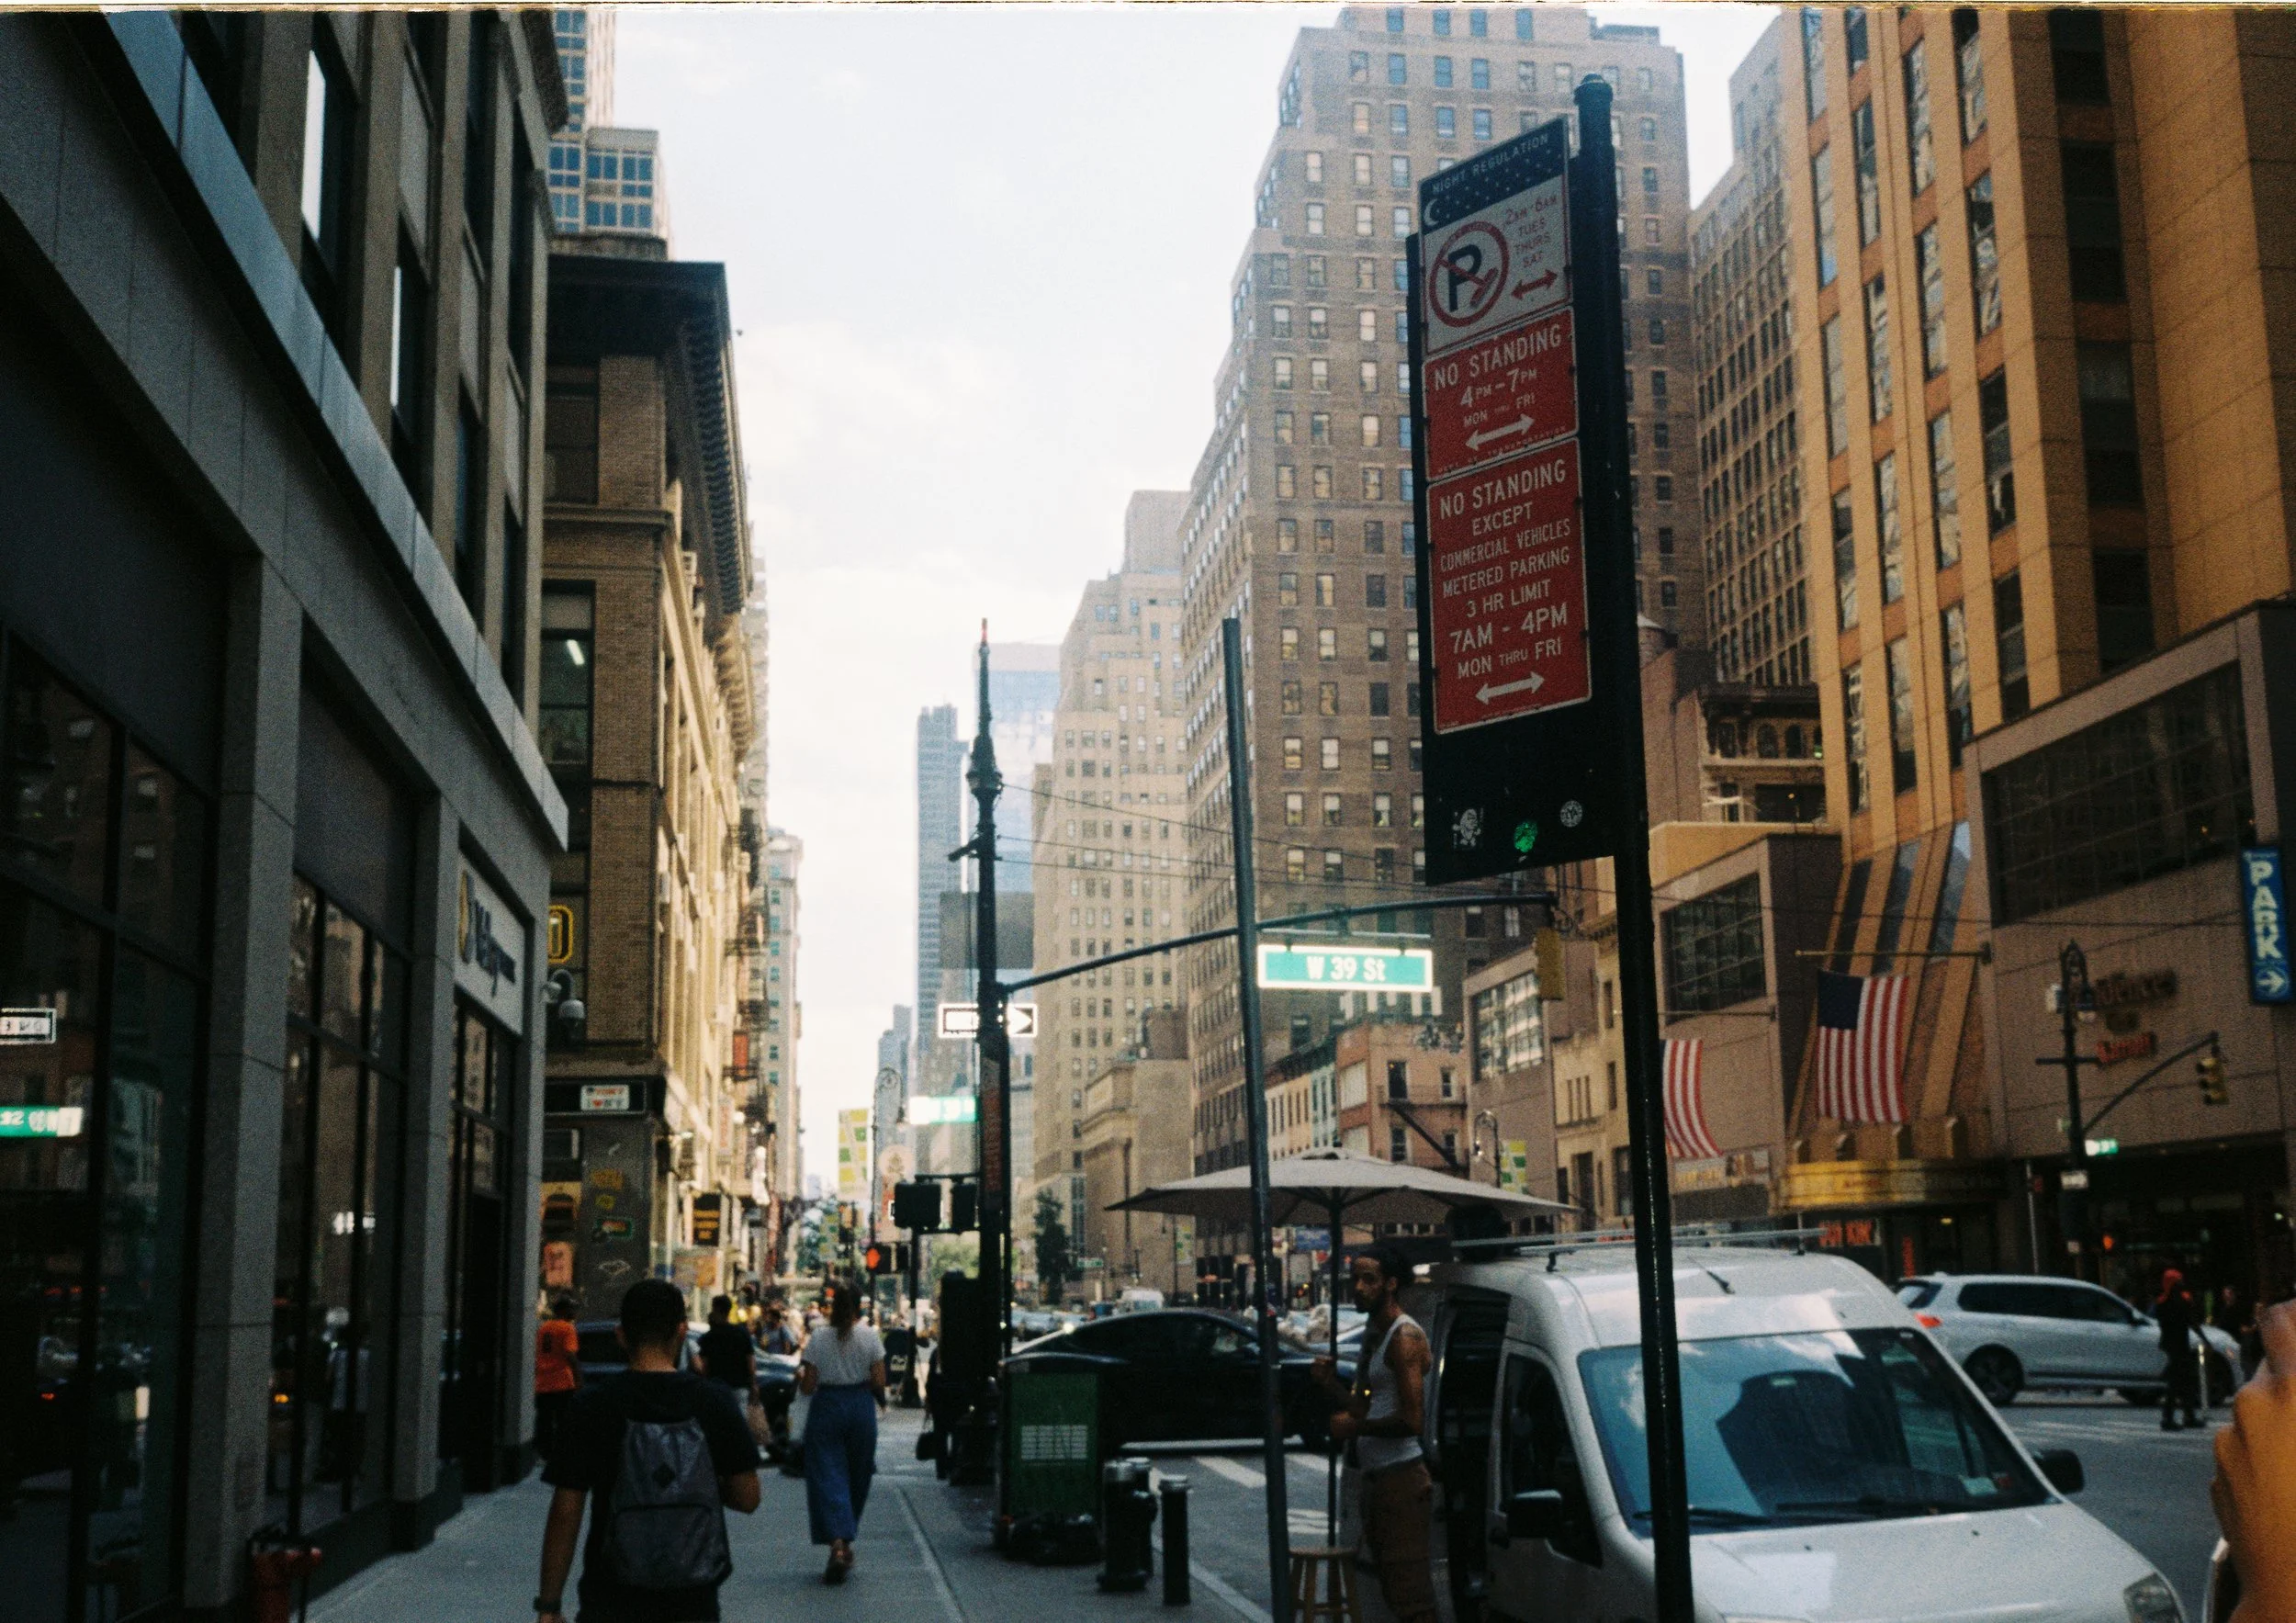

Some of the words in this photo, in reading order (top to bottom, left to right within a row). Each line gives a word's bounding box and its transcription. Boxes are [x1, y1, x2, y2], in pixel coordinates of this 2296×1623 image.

[1432, 170, 1465, 195] NIGHT
[1472, 133, 1548, 175] REGULATION
[1515, 231, 1551, 254] THURS
[1518, 217, 1546, 237] TUES
[1523, 251, 1544, 268] SAT
[1434, 363, 1458, 391] NO
[1469, 323, 1561, 378] STANDING
[1459, 384, 1492, 408] 4PM
[1507, 367, 1537, 393] 7PM
[1464, 410, 1488, 428] MON
[1516, 393, 1536, 410] FRI
[1440, 492, 1465, 520] NO
[1472, 459, 1566, 509] STANDING
[1472, 502, 1533, 536] EXCEPT
[1440, 536, 1511, 572] COMMERCIAL
[1517, 518, 1570, 549] VEHICLES
[1443, 566, 1503, 598] METERED
[1510, 546, 1570, 580] PARKING
[1467, 600, 1477, 618] 3
[1482, 592, 1504, 614] HR
[1511, 579, 1552, 606] LIMIT
[1449, 622, 1492, 654] 7AM
[1521, 602, 1568, 634] 4PM
[1458, 655, 1492, 680] MON
[1499, 648, 1529, 666] THRU
[1535, 637, 1562, 660] FRI
[2250, 861, 2282, 959] PARK
[1306, 955, 1324, 980] W
[1330, 956, 1357, 981] 39
[1363, 957, 1387, 982] St
